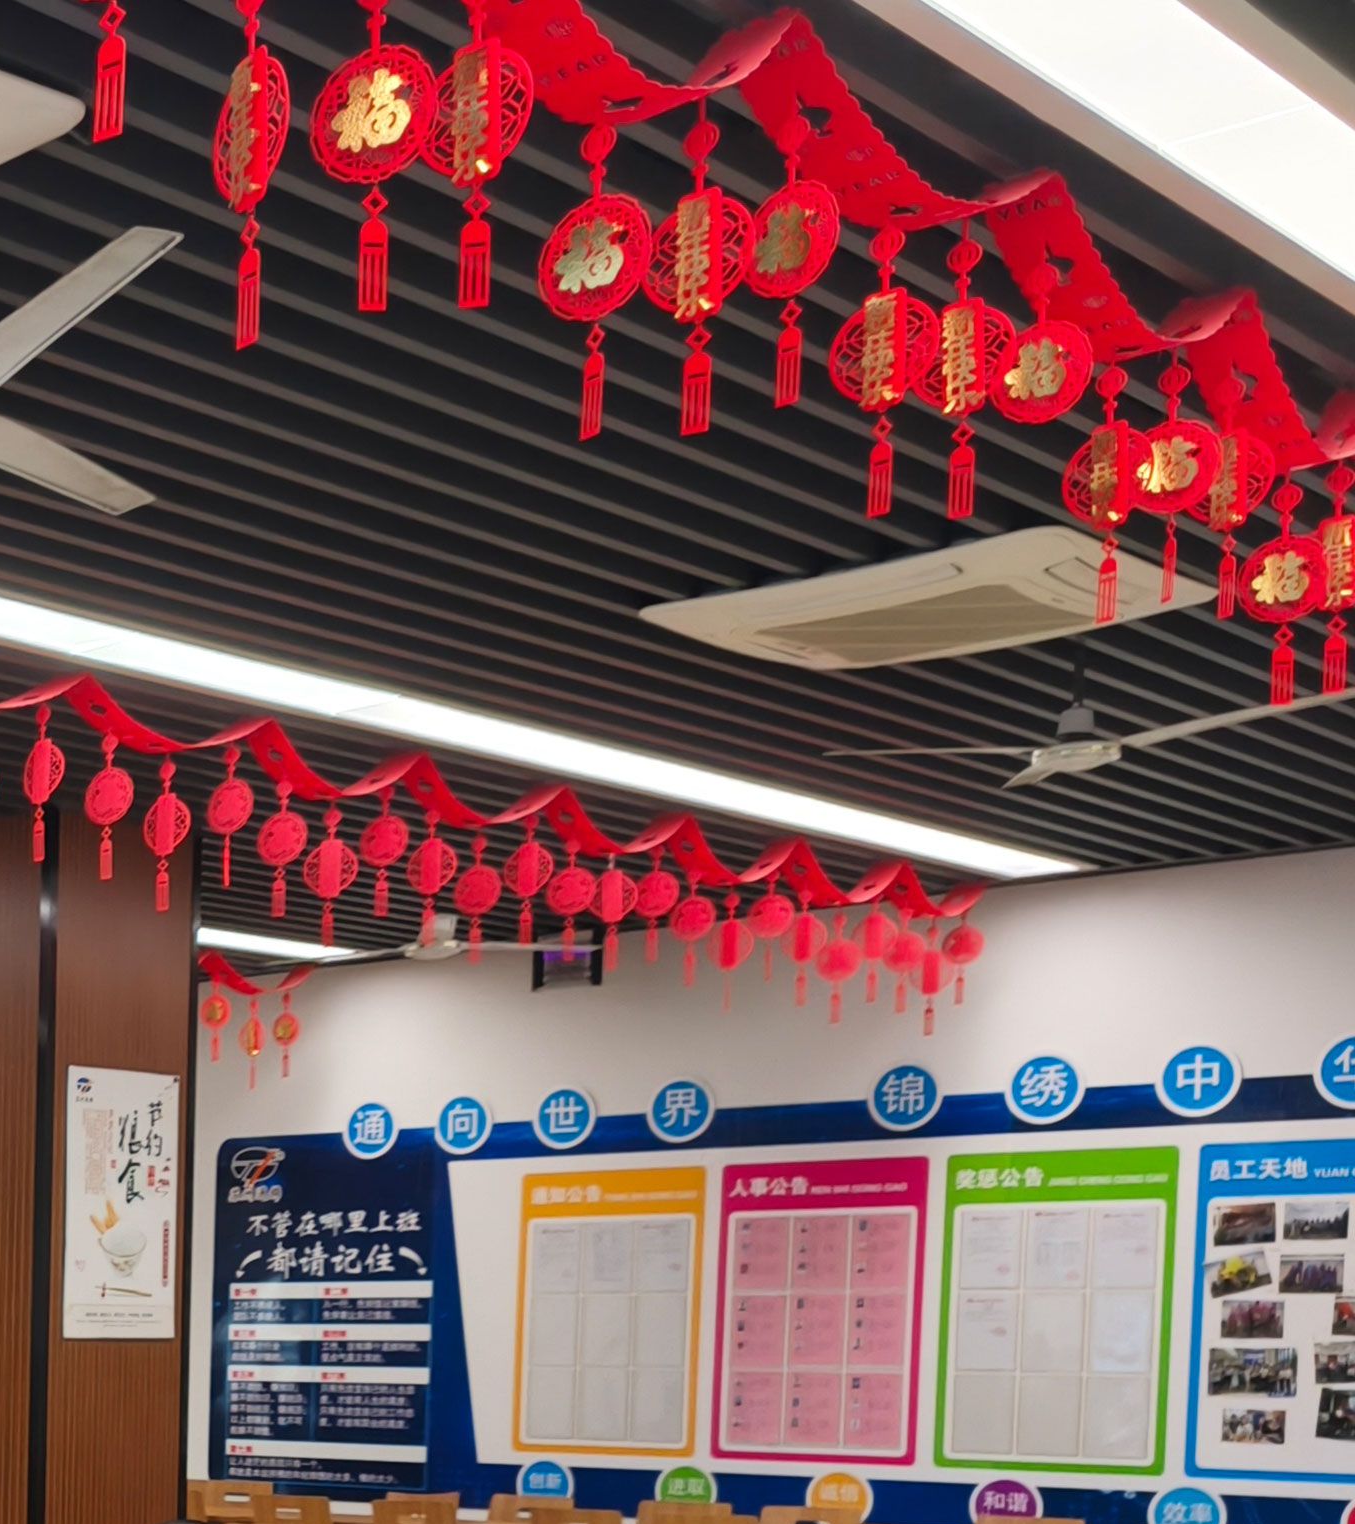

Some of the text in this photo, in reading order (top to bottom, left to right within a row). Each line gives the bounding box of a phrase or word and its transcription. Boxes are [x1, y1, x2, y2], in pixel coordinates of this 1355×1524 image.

[331, 68, 412, 153] 福
[554, 217, 624, 294] 福
[1003, 338, 1065, 401] 福
[1136, 436, 1199, 494] 福
[1251, 551, 1310, 605] 福
[353, 1088, 701, 1147] 通向世界
[729, 1176, 808, 1198] 人事公告
[1210, 1157, 1308, 1181] 员工天地
[246, 1209, 423, 1238] 不管在哪里上班
[266, 1241, 396, 1280] 都请记住
[528, 1472, 562, 1490] 创新
[983, 1490, 1029, 1513] 和谐
[1162, 1502, 1213, 1524] 效率
